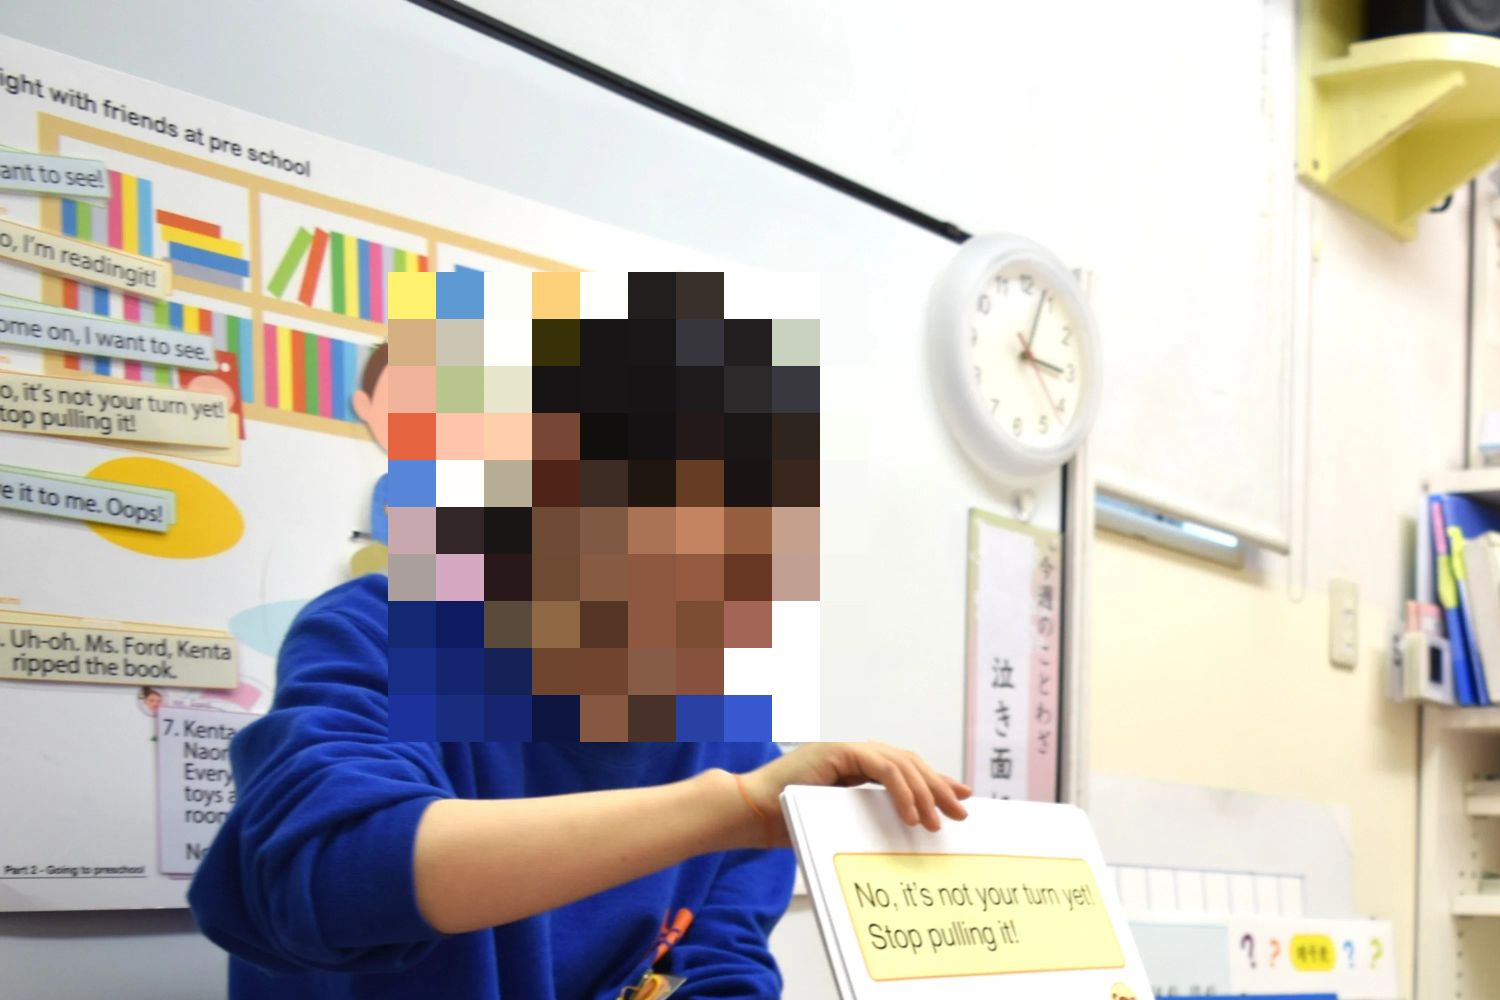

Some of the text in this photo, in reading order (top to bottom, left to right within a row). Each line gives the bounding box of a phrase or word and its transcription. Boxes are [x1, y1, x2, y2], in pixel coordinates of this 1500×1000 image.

[49, 87, 97, 114] with
[103, 100, 178, 138] friends
[185, 127, 206, 146] at
[209, 134, 242, 157] pre
[247, 146, 311, 177] school
[39, 165, 61, 184] to
[66, 169, 104, 188] see!
[23, 235, 55, 260] I'm
[47, 325, 80, 346] on,
[85, 326, 91, 344] I
[95, 331, 146, 352] want
[151, 339, 171, 356] to
[174, 343, 211, 361] see.
[22, 382, 51, 403] it's
[58, 388, 94, 406] not
[97, 394, 143, 412] your
[147, 399, 188, 415] turn
[191, 401, 224, 420] yet!
[41, 408, 112, 435] pulling
[116, 414, 136, 433] it!
[19, 483, 34, 502] it
[38, 487, 60, 506] to
[64, 494, 103, 513] me.
[106, 497, 163, 524] Oops!
[9, 629, 232, 661] Uh-oh. Ms. Ford, Kenta
[12, 653, 178, 679] ripped the book.
[162, 719, 236, 740] 7. Kenta
[989, 657, 1015, 799] 泣き面
[184, 787, 228, 807] toys
[4, 865, 28, 875] Part
[30, 865, 38, 875] 2
[46, 865, 78, 877] Going
[81, 865, 91, 875] to
[93, 865, 145, 876] preschool
[854, 881, 1096, 912] No, it's not your turn yet!
[868, 919, 1020, 954] Stop pulling it!
